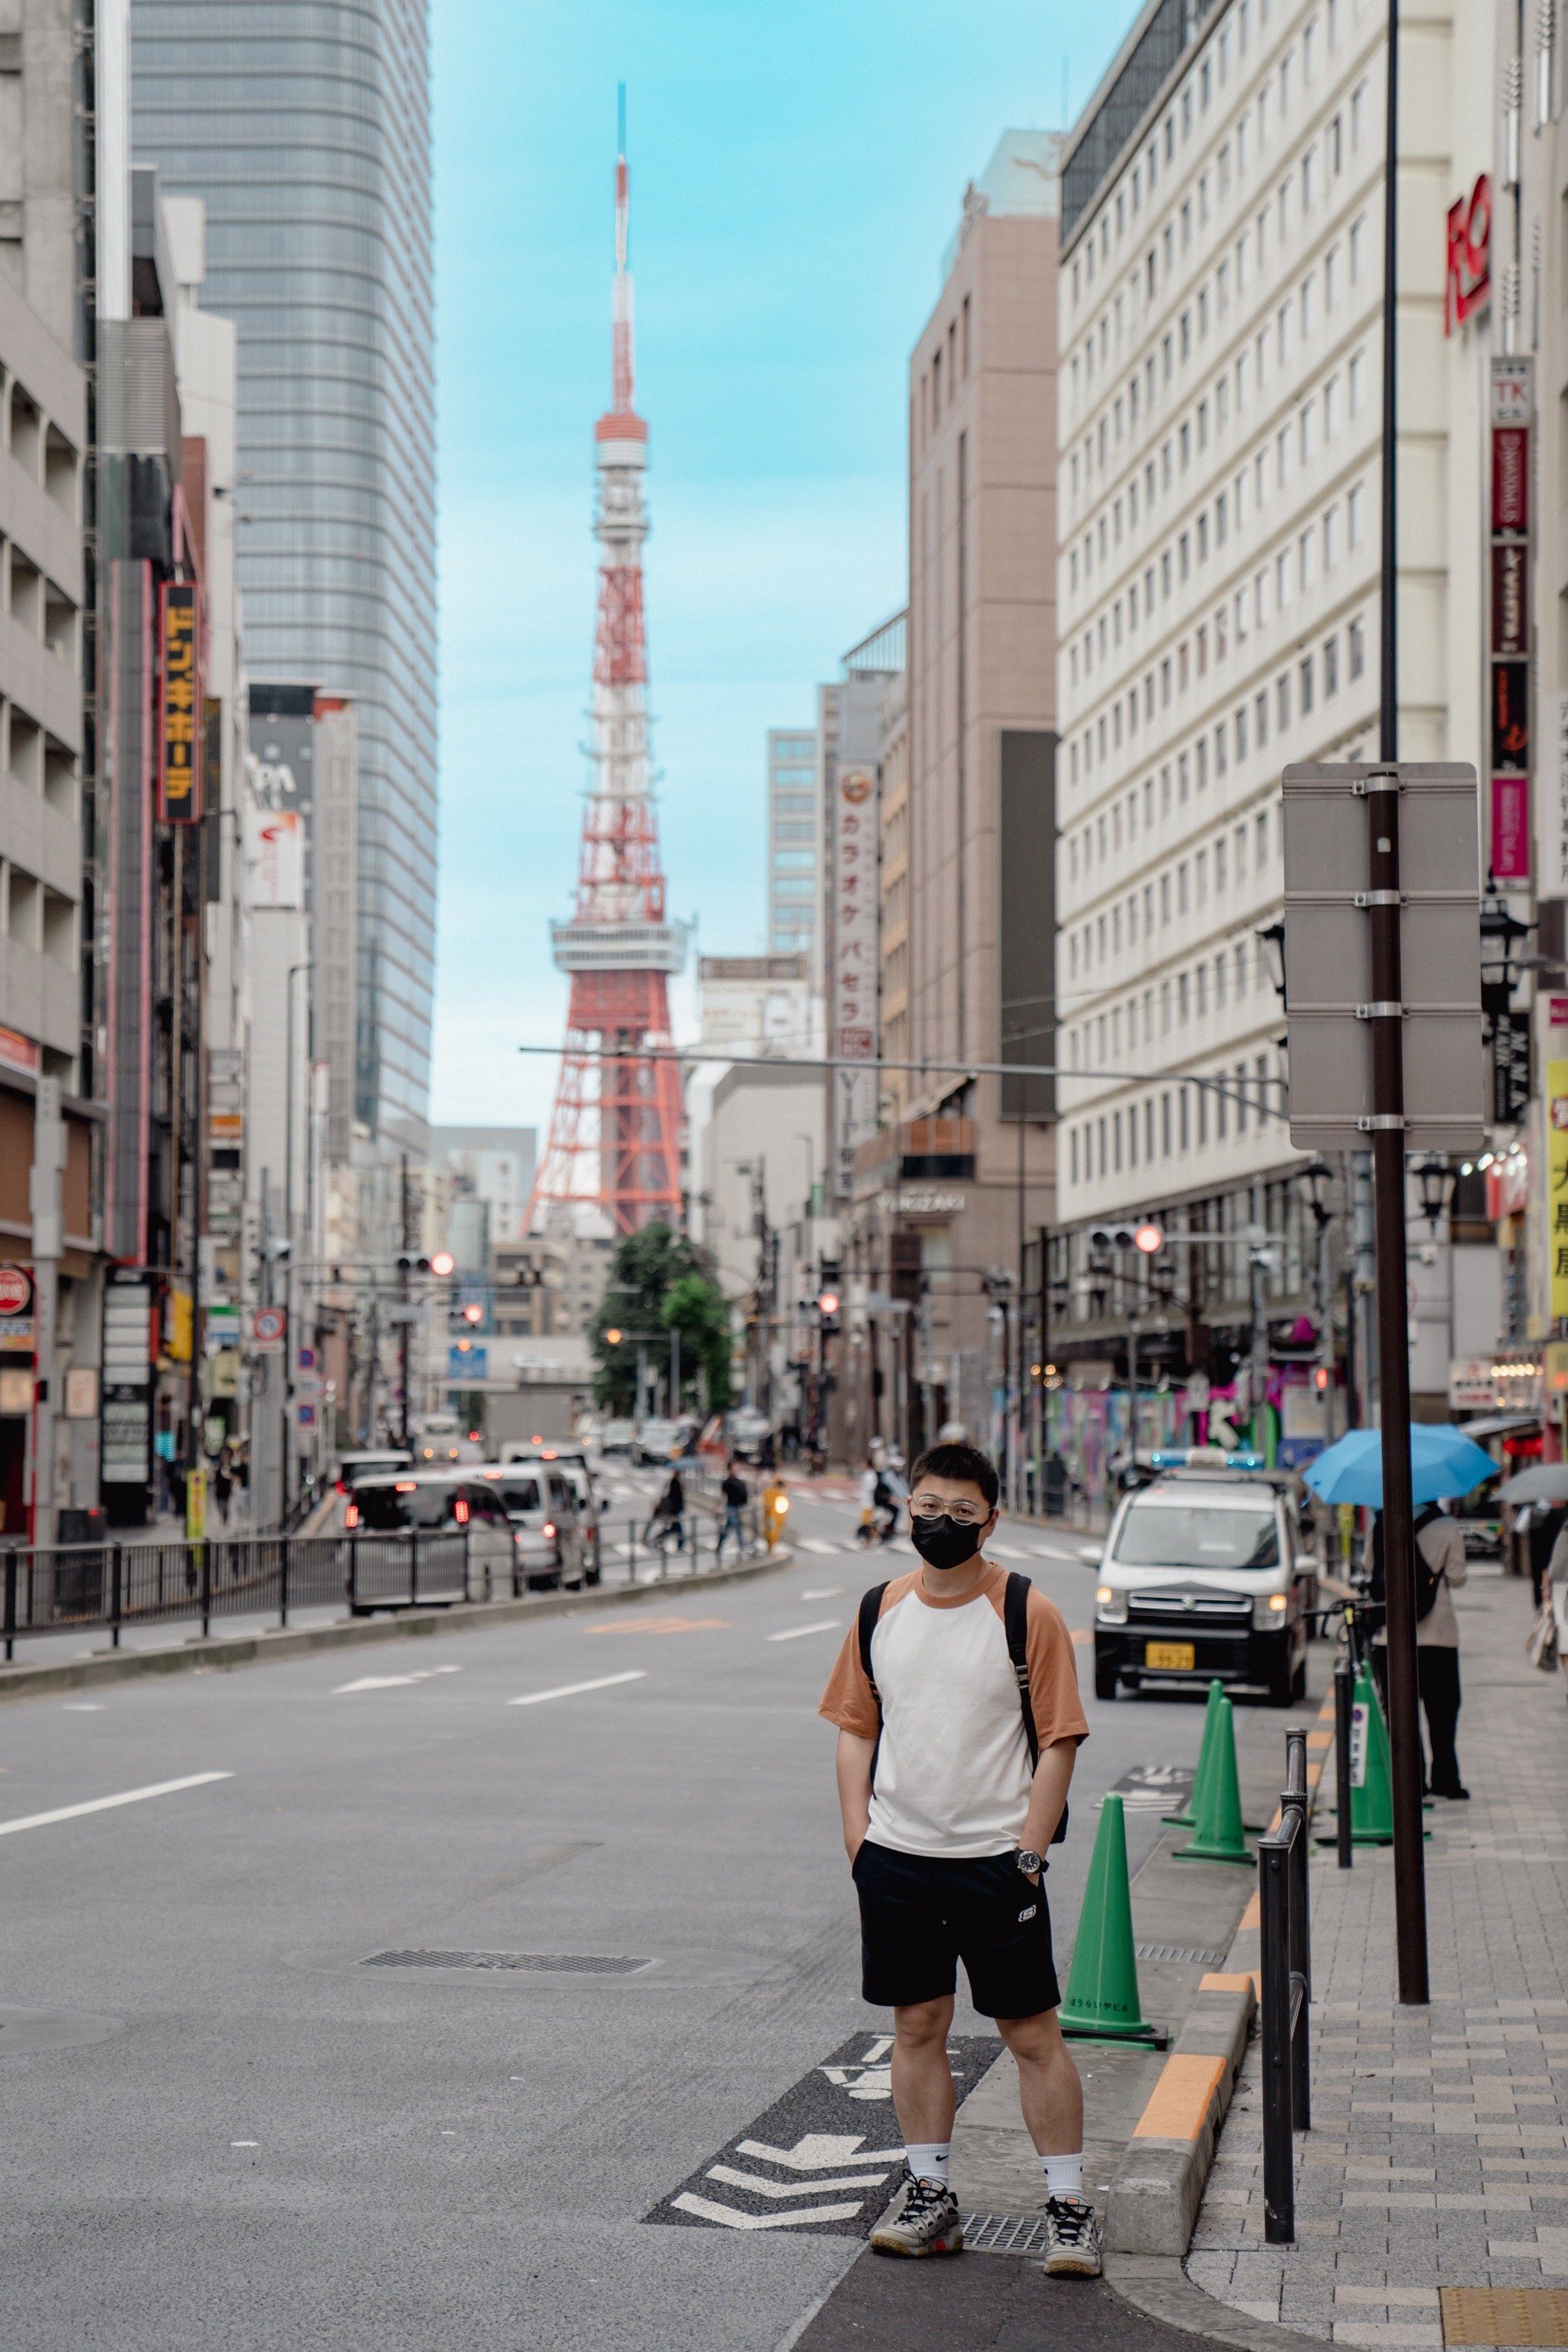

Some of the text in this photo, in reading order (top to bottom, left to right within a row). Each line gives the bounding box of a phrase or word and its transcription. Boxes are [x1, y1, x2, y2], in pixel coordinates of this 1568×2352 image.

[1494, 381, 1527, 402] TK
[166, 605, 194, 800] ドン・キホーテ
